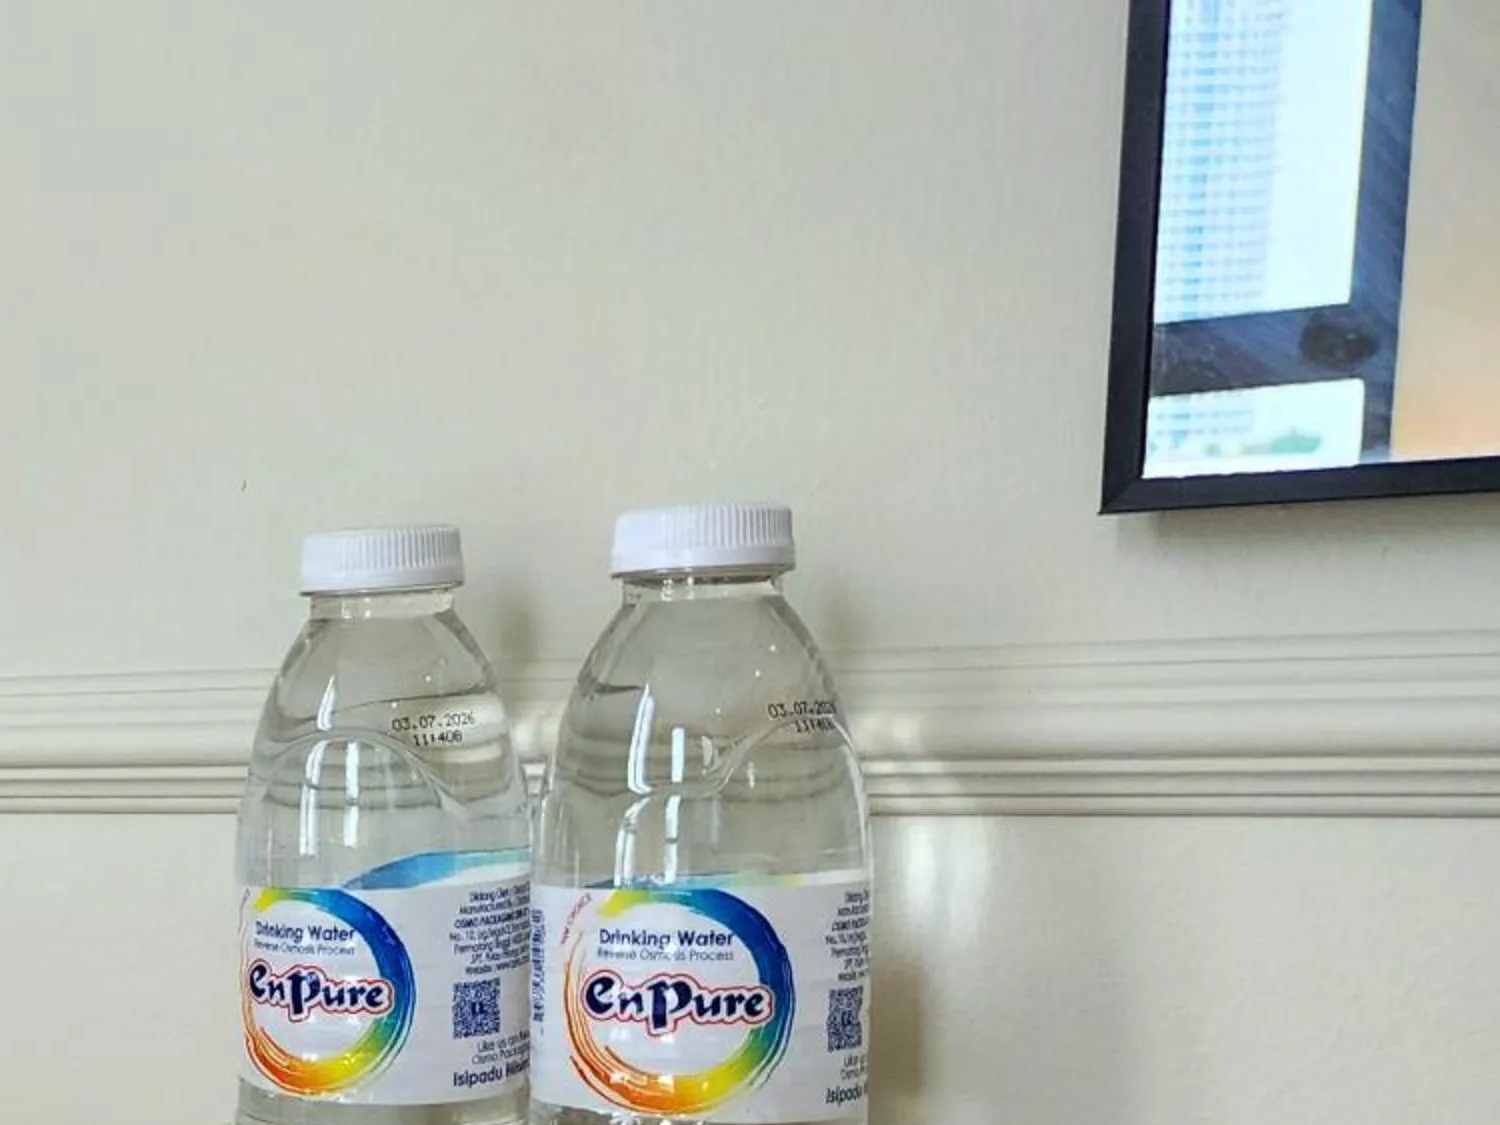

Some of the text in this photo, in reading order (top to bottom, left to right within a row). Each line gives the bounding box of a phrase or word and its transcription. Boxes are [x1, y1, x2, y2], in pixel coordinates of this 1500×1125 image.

[255, 920, 355, 944] Drinking Water
[599, 928, 734, 951] Drinking Water
[688, 948, 734, 961] Process
[453, 1066, 503, 1089] Isipadu
